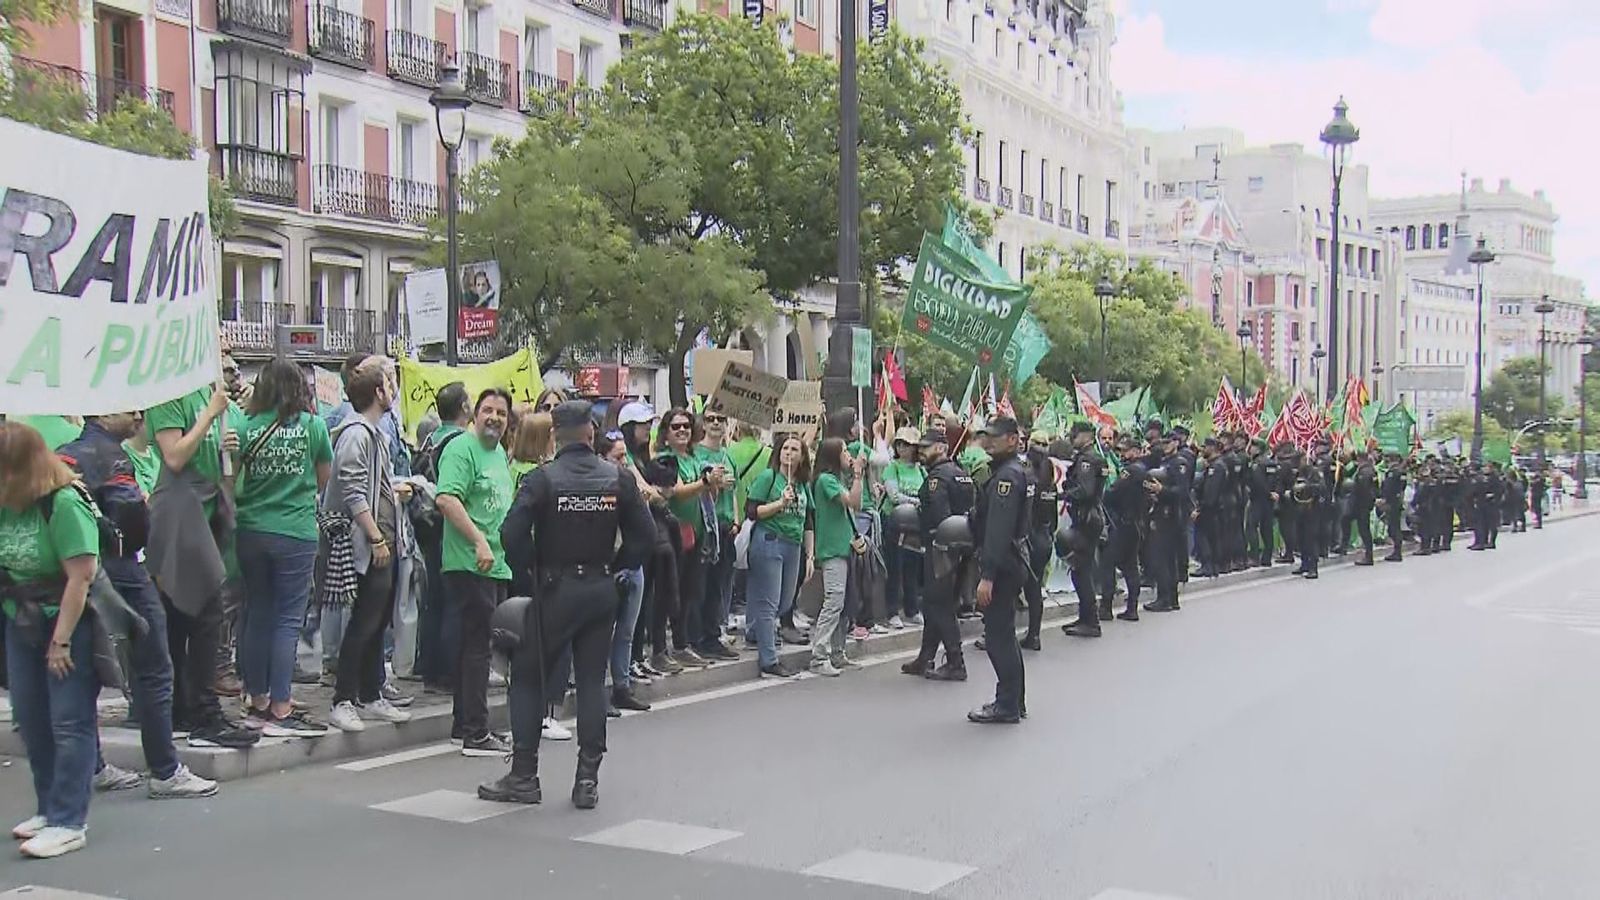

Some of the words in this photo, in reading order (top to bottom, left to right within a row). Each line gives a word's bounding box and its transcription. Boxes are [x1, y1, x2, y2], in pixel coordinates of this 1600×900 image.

[923, 261, 1012, 320] DIGNIDAD
[913, 289, 960, 329] ESCUELA
[465, 319, 494, 331] Dream
[90, 303, 214, 388] PÚBLIC
[788, 409, 818, 425] HORAS
[558, 503, 617, 512] NACIONAL
